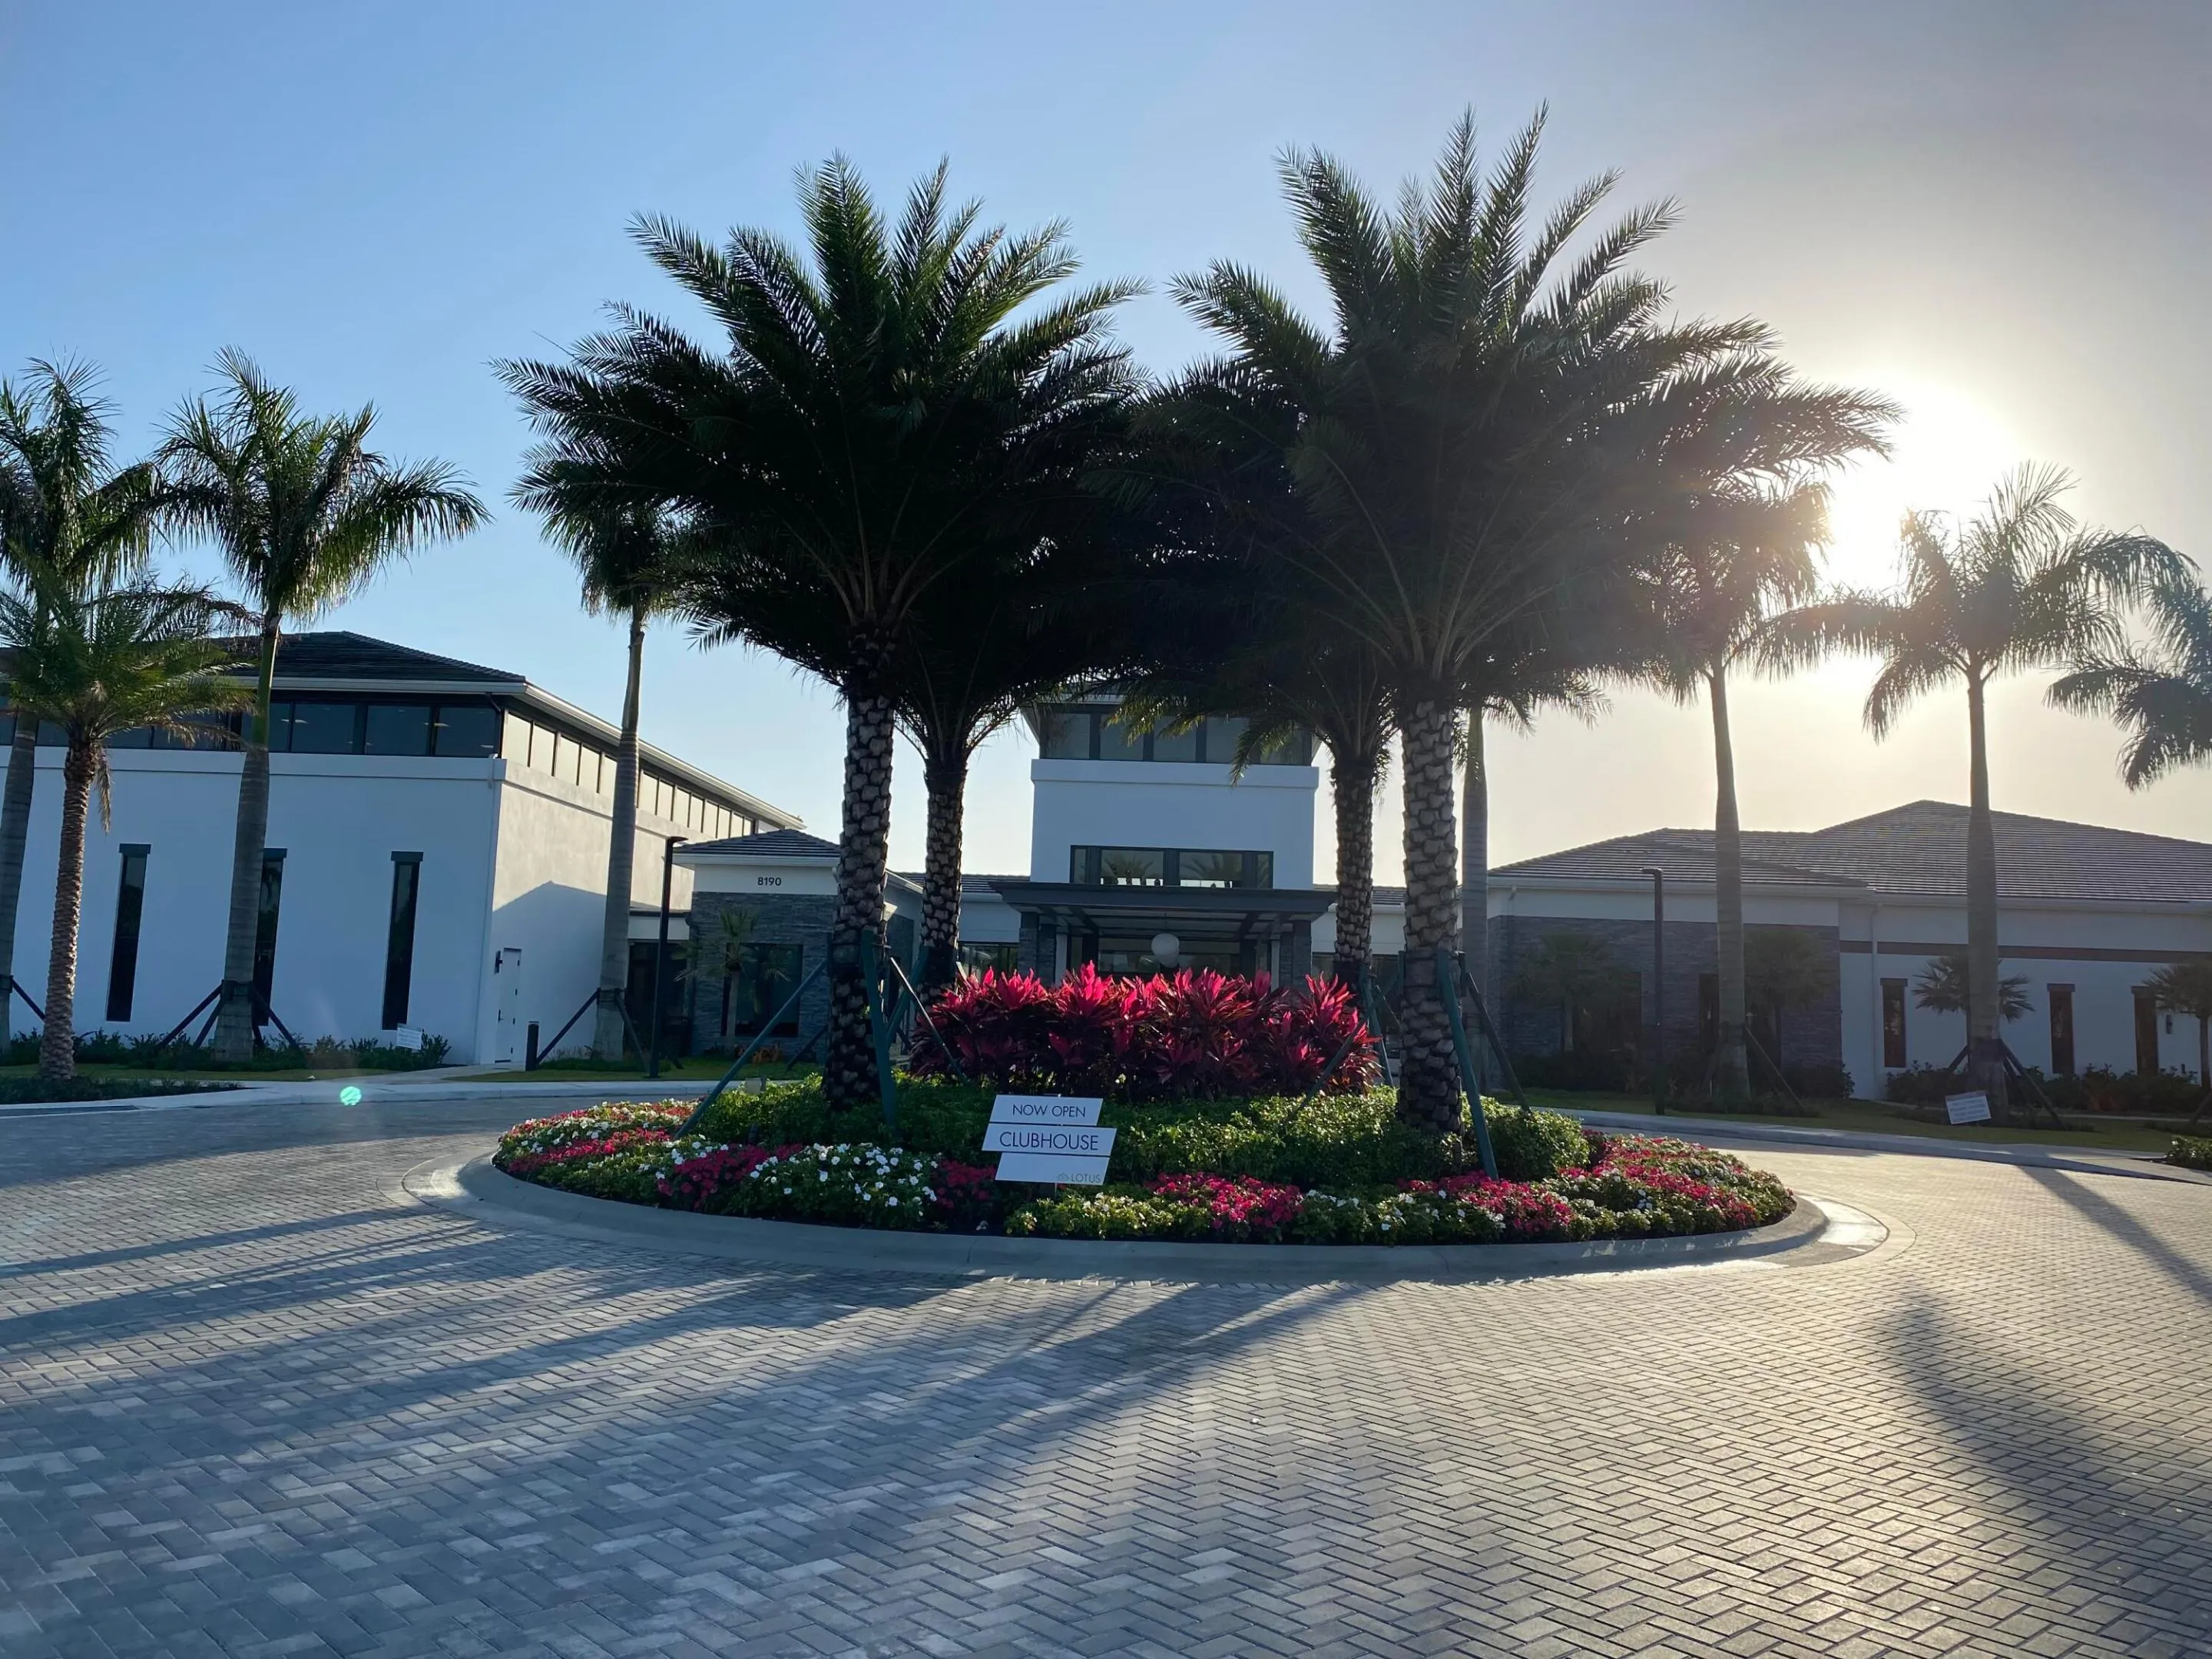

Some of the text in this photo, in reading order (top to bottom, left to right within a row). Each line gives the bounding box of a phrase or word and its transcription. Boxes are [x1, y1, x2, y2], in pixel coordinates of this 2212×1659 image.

[757, 876, 782, 886] 8190
[1012, 1104, 1086, 1118] NOW OPEN
[999, 1131, 1099, 1151] CLUBHOUSE
[1071, 1173, 1101, 1184] LOTUS
